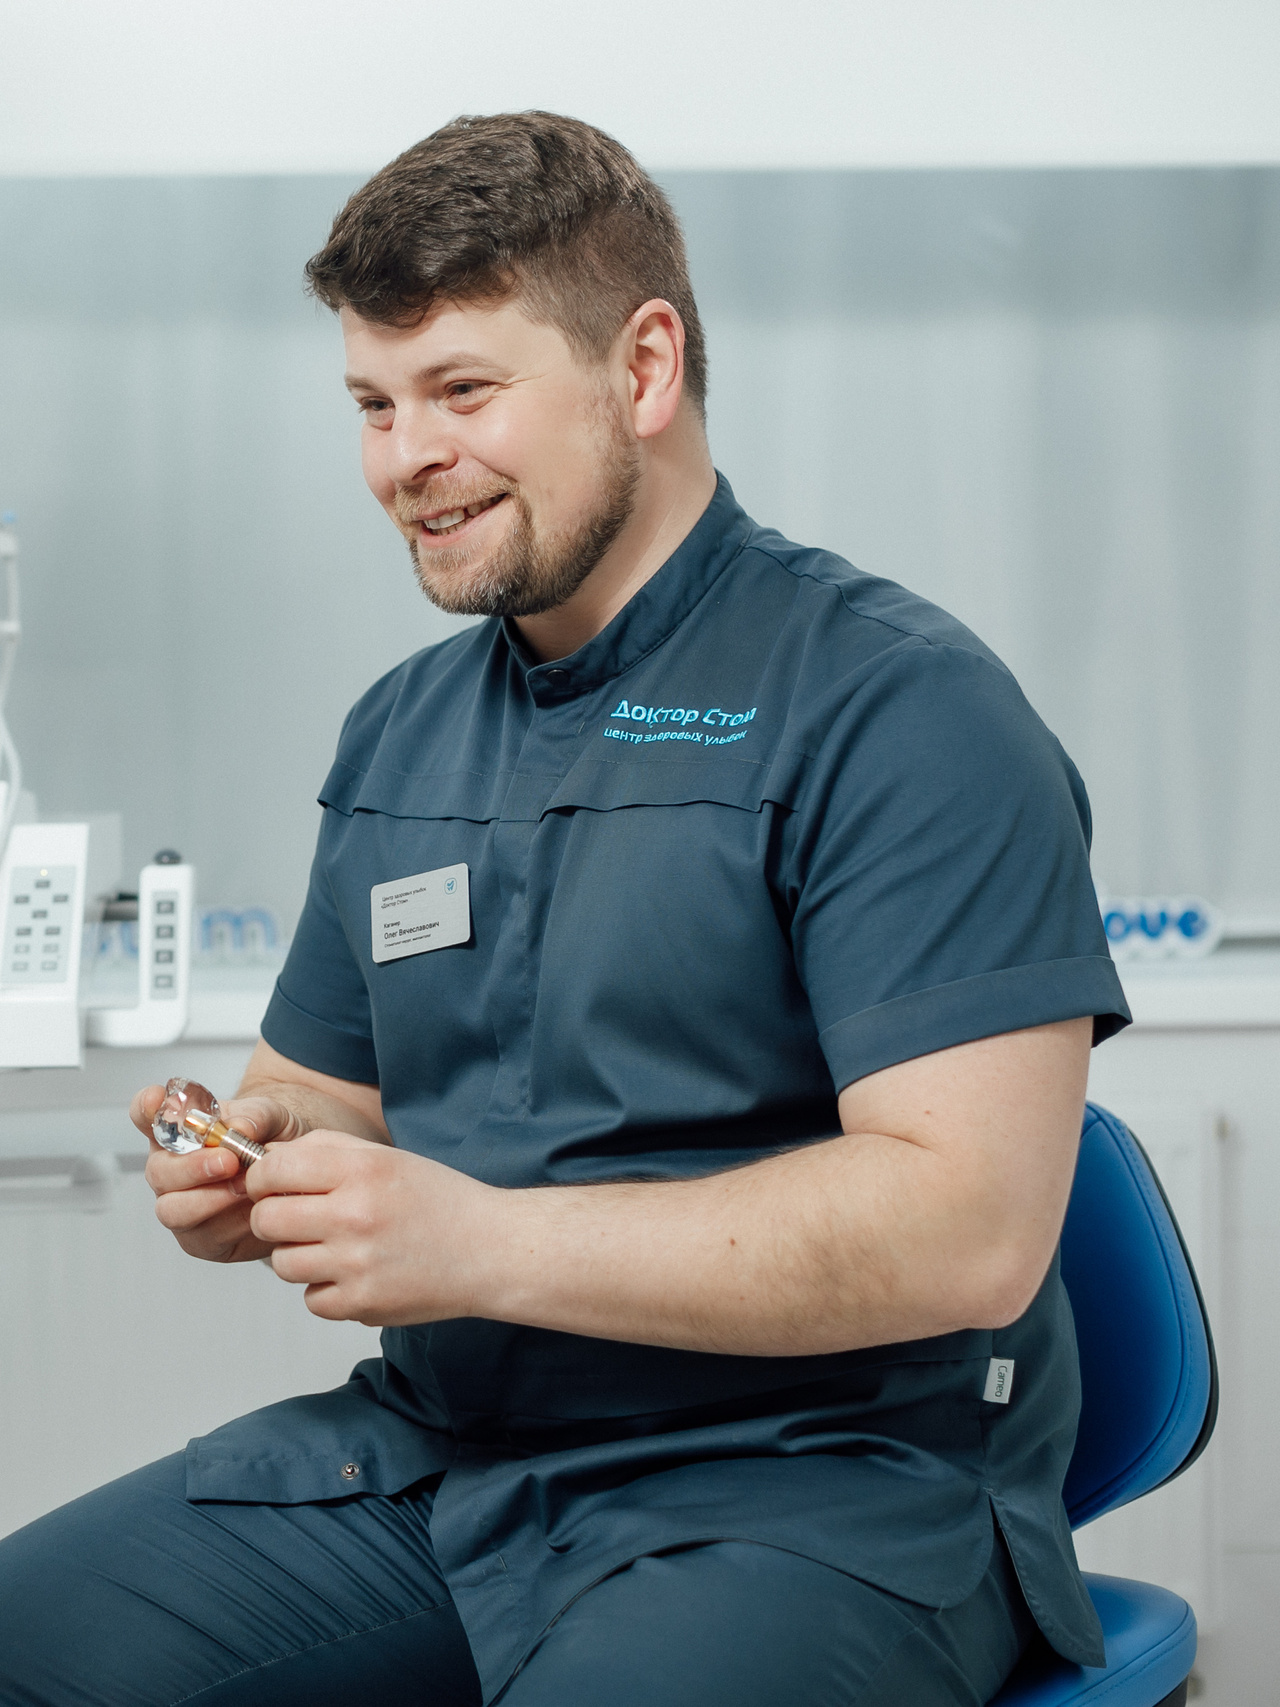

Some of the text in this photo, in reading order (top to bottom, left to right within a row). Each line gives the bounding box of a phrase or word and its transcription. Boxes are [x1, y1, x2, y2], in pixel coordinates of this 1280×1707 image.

[610, 699, 700, 728] Доктор
[1104, 910, 1207, 942] ove
[994, 1365, 1008, 1397] Cameo
